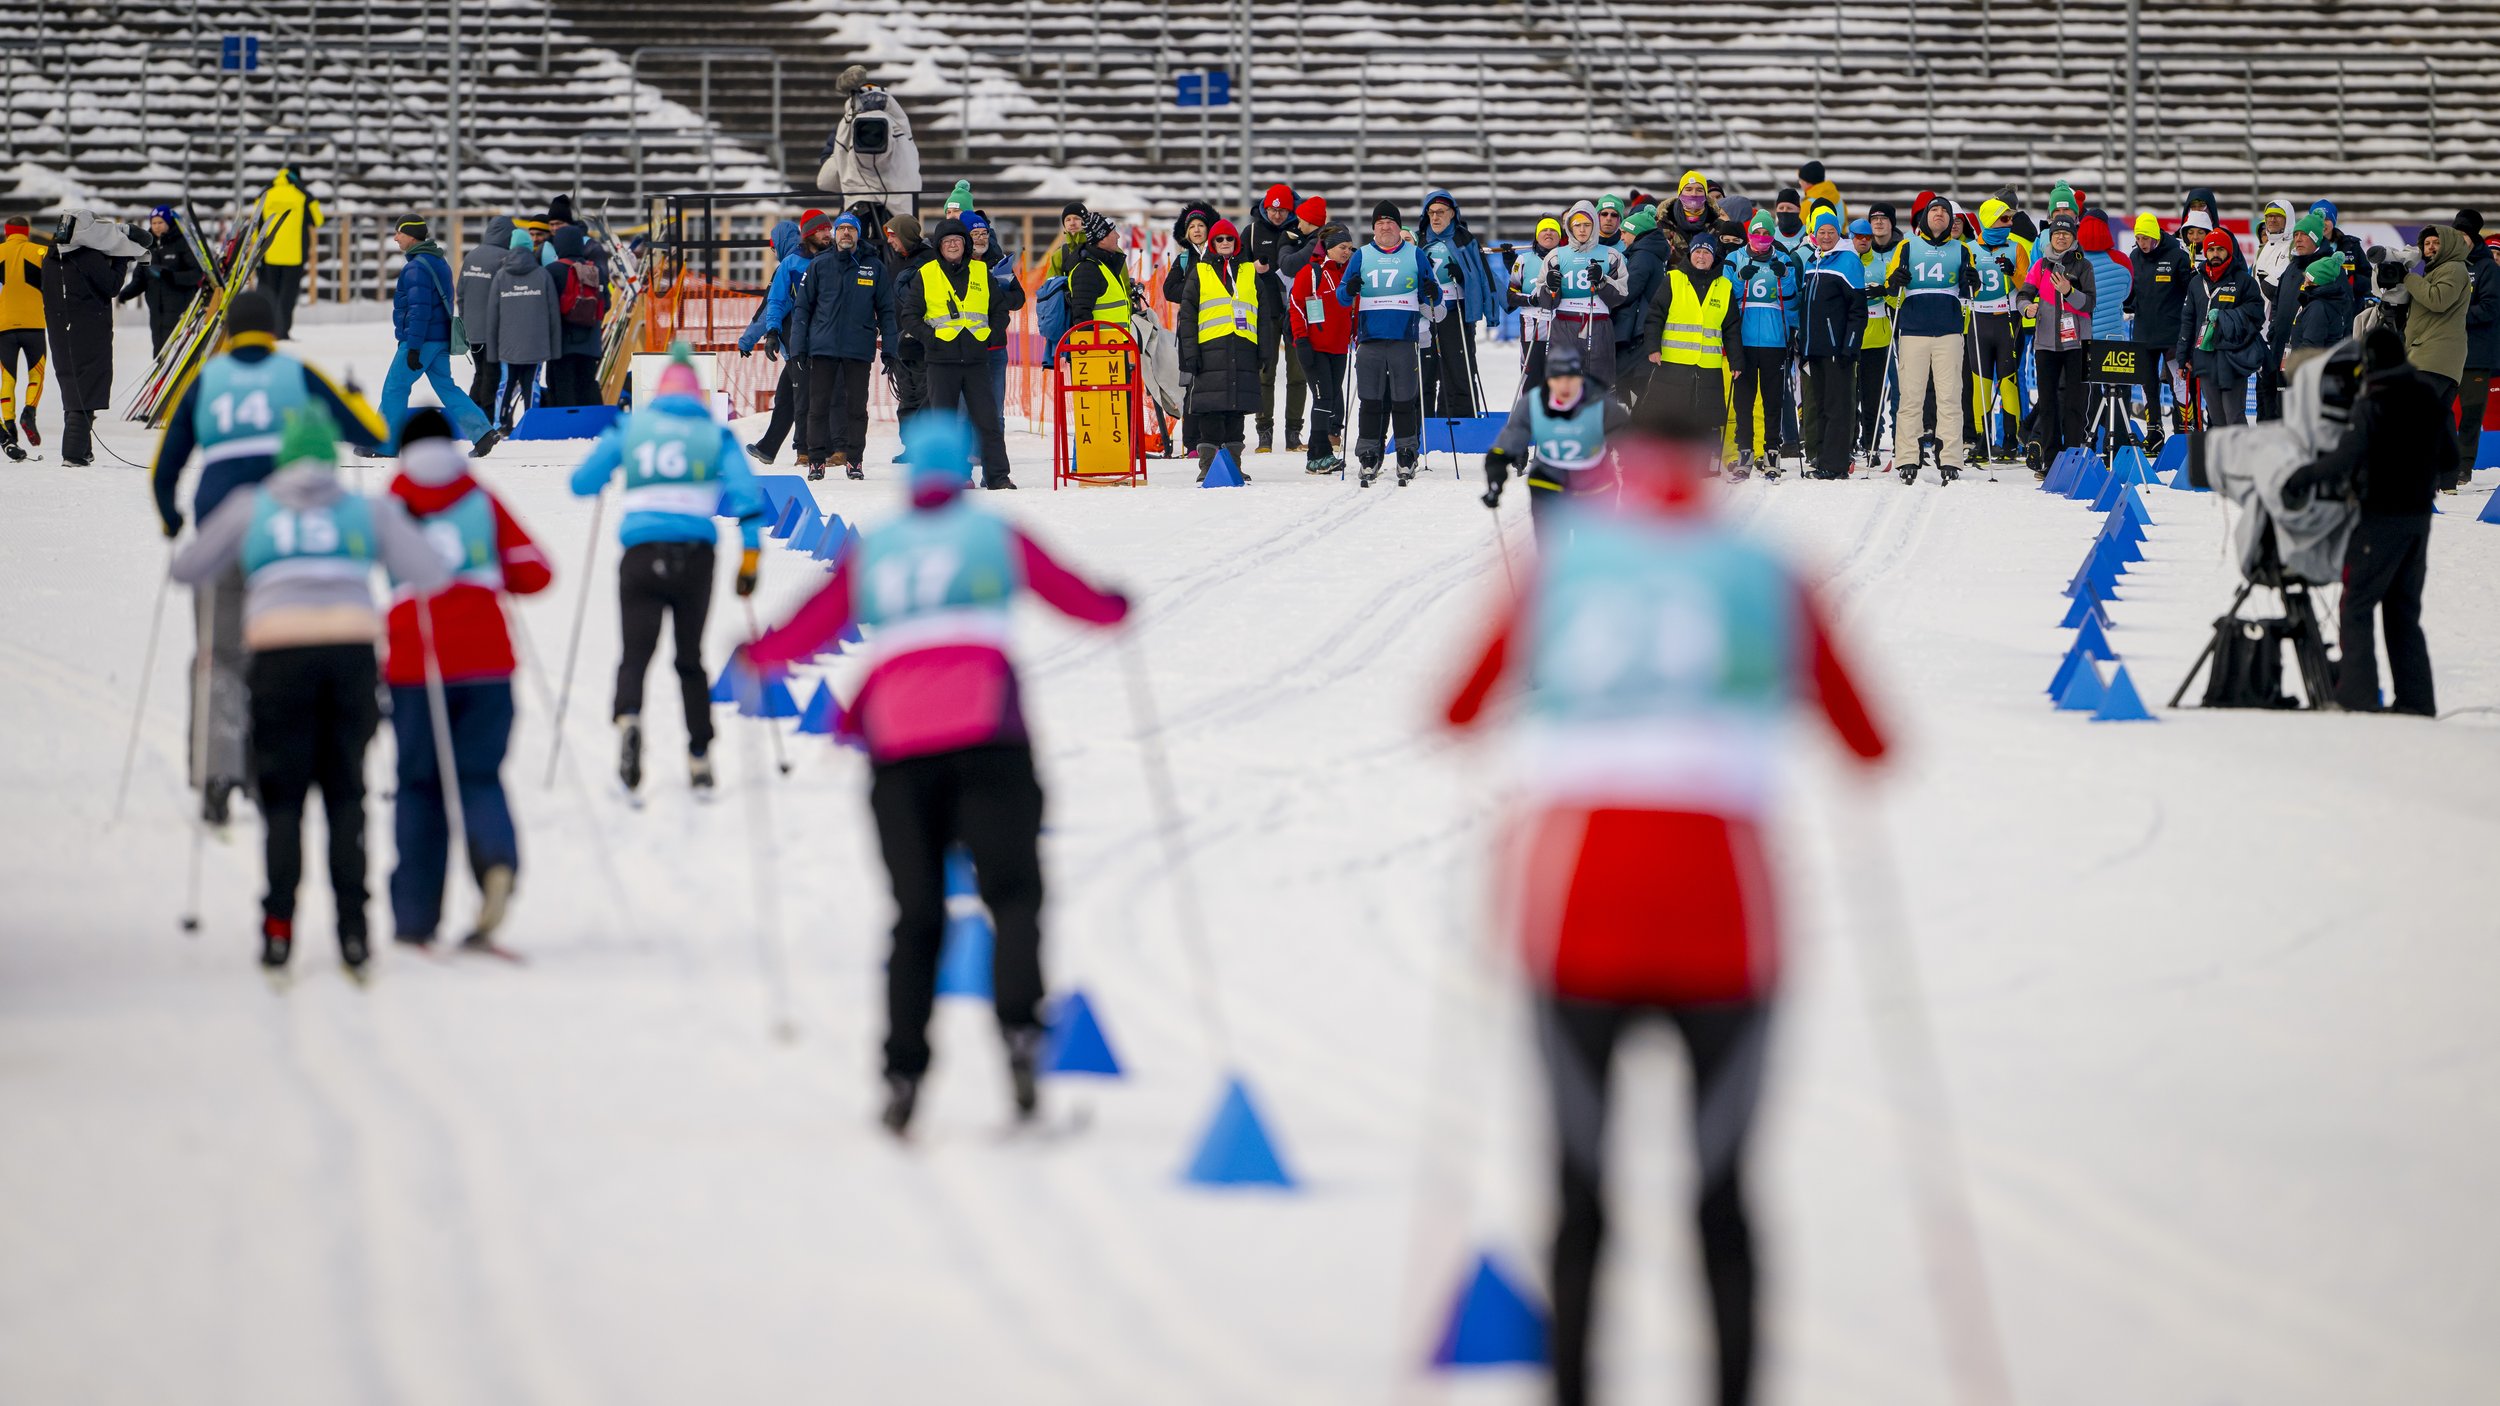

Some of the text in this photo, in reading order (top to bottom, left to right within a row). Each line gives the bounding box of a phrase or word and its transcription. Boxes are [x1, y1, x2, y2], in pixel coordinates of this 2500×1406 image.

[1366, 269, 1415, 289] 17 2
[1563, 269, 1592, 290] 18
[1914, 262, 1957, 284] 14 2
[1770, 287, 1777, 299] 2
[2102, 350, 2136, 367] ALGE
[208, 390, 274, 433] 14
[1078, 362, 1092, 444] ZELLA
[1108, 361, 1122, 443] MEHLIS
[632, 439, 690, 478] 16
[1543, 440, 1582, 461] 12
